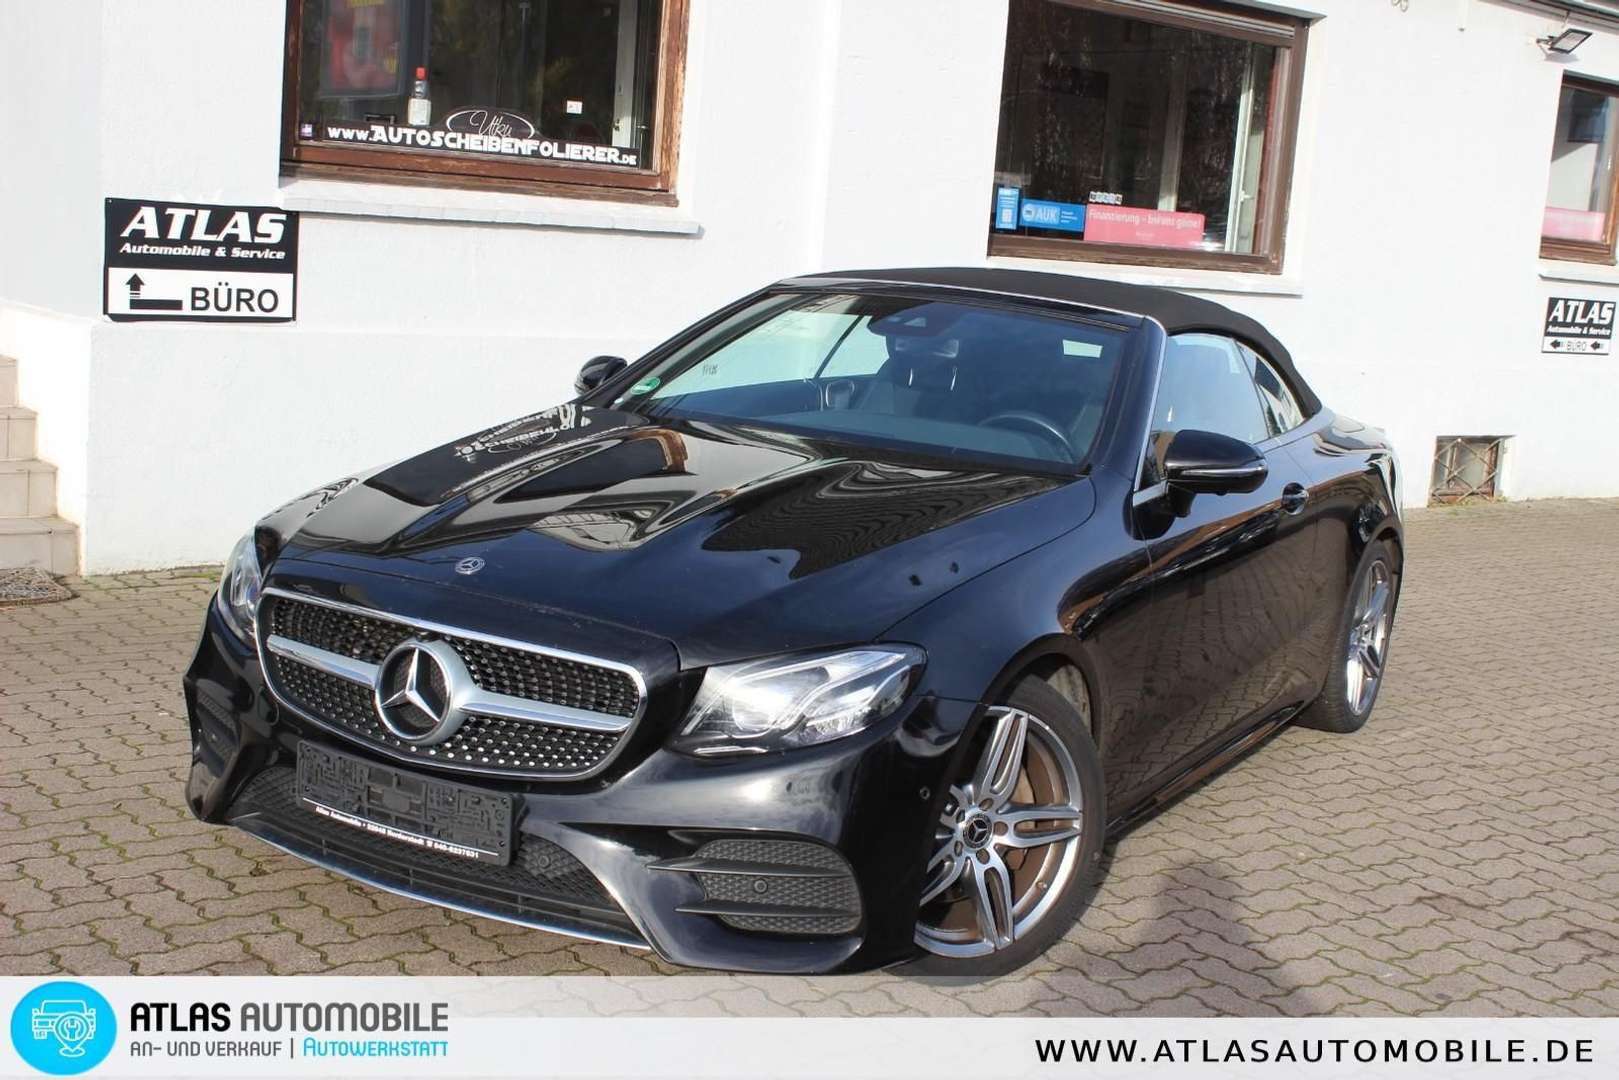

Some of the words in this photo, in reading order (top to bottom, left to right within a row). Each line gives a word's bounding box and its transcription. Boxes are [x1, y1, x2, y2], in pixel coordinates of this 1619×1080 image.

[120, 206, 287, 244] ATLAS
[120, 242, 211, 257] Automobile
[215, 246, 226, 257] &
[231, 247, 285, 259] Service
[191, 282, 279, 313] BÜRO
[1548, 300, 1614, 325] ATLAS
